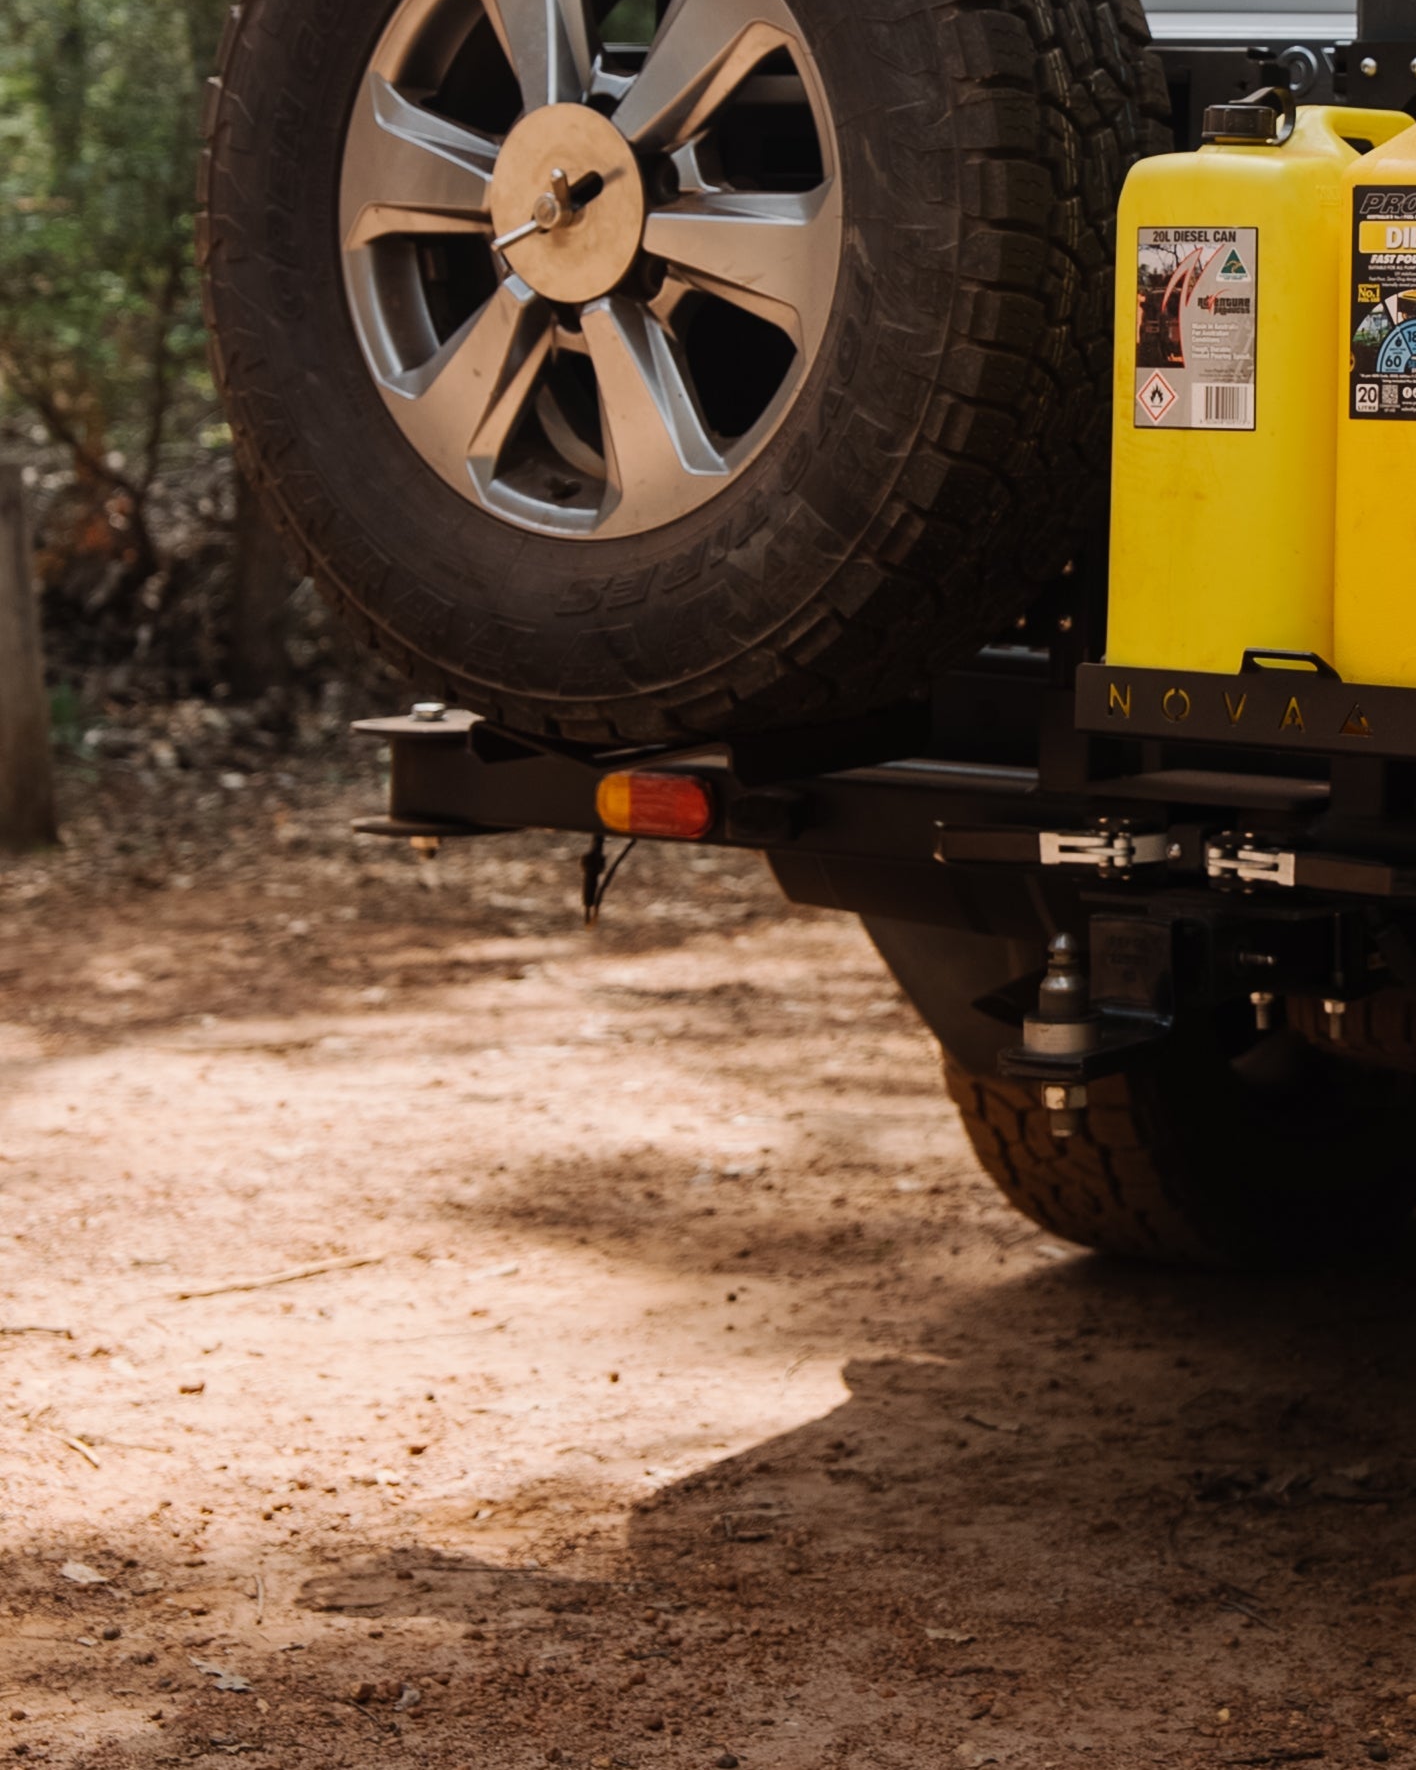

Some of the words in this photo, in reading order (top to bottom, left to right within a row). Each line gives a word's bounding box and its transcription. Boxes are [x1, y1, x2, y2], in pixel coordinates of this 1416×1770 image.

[1153, 230, 1170, 242] 20L
[1173, 231, 1209, 242] DIESEL
[1213, 231, 1236, 242] CAN
[1370, 255, 1396, 265] FAST
[1385, 356, 1402, 368] 60
[1358, 386, 1377, 403] 20
[552, 488, 774, 616] TIRES
[1105, 681, 1306, 732] NOVA
